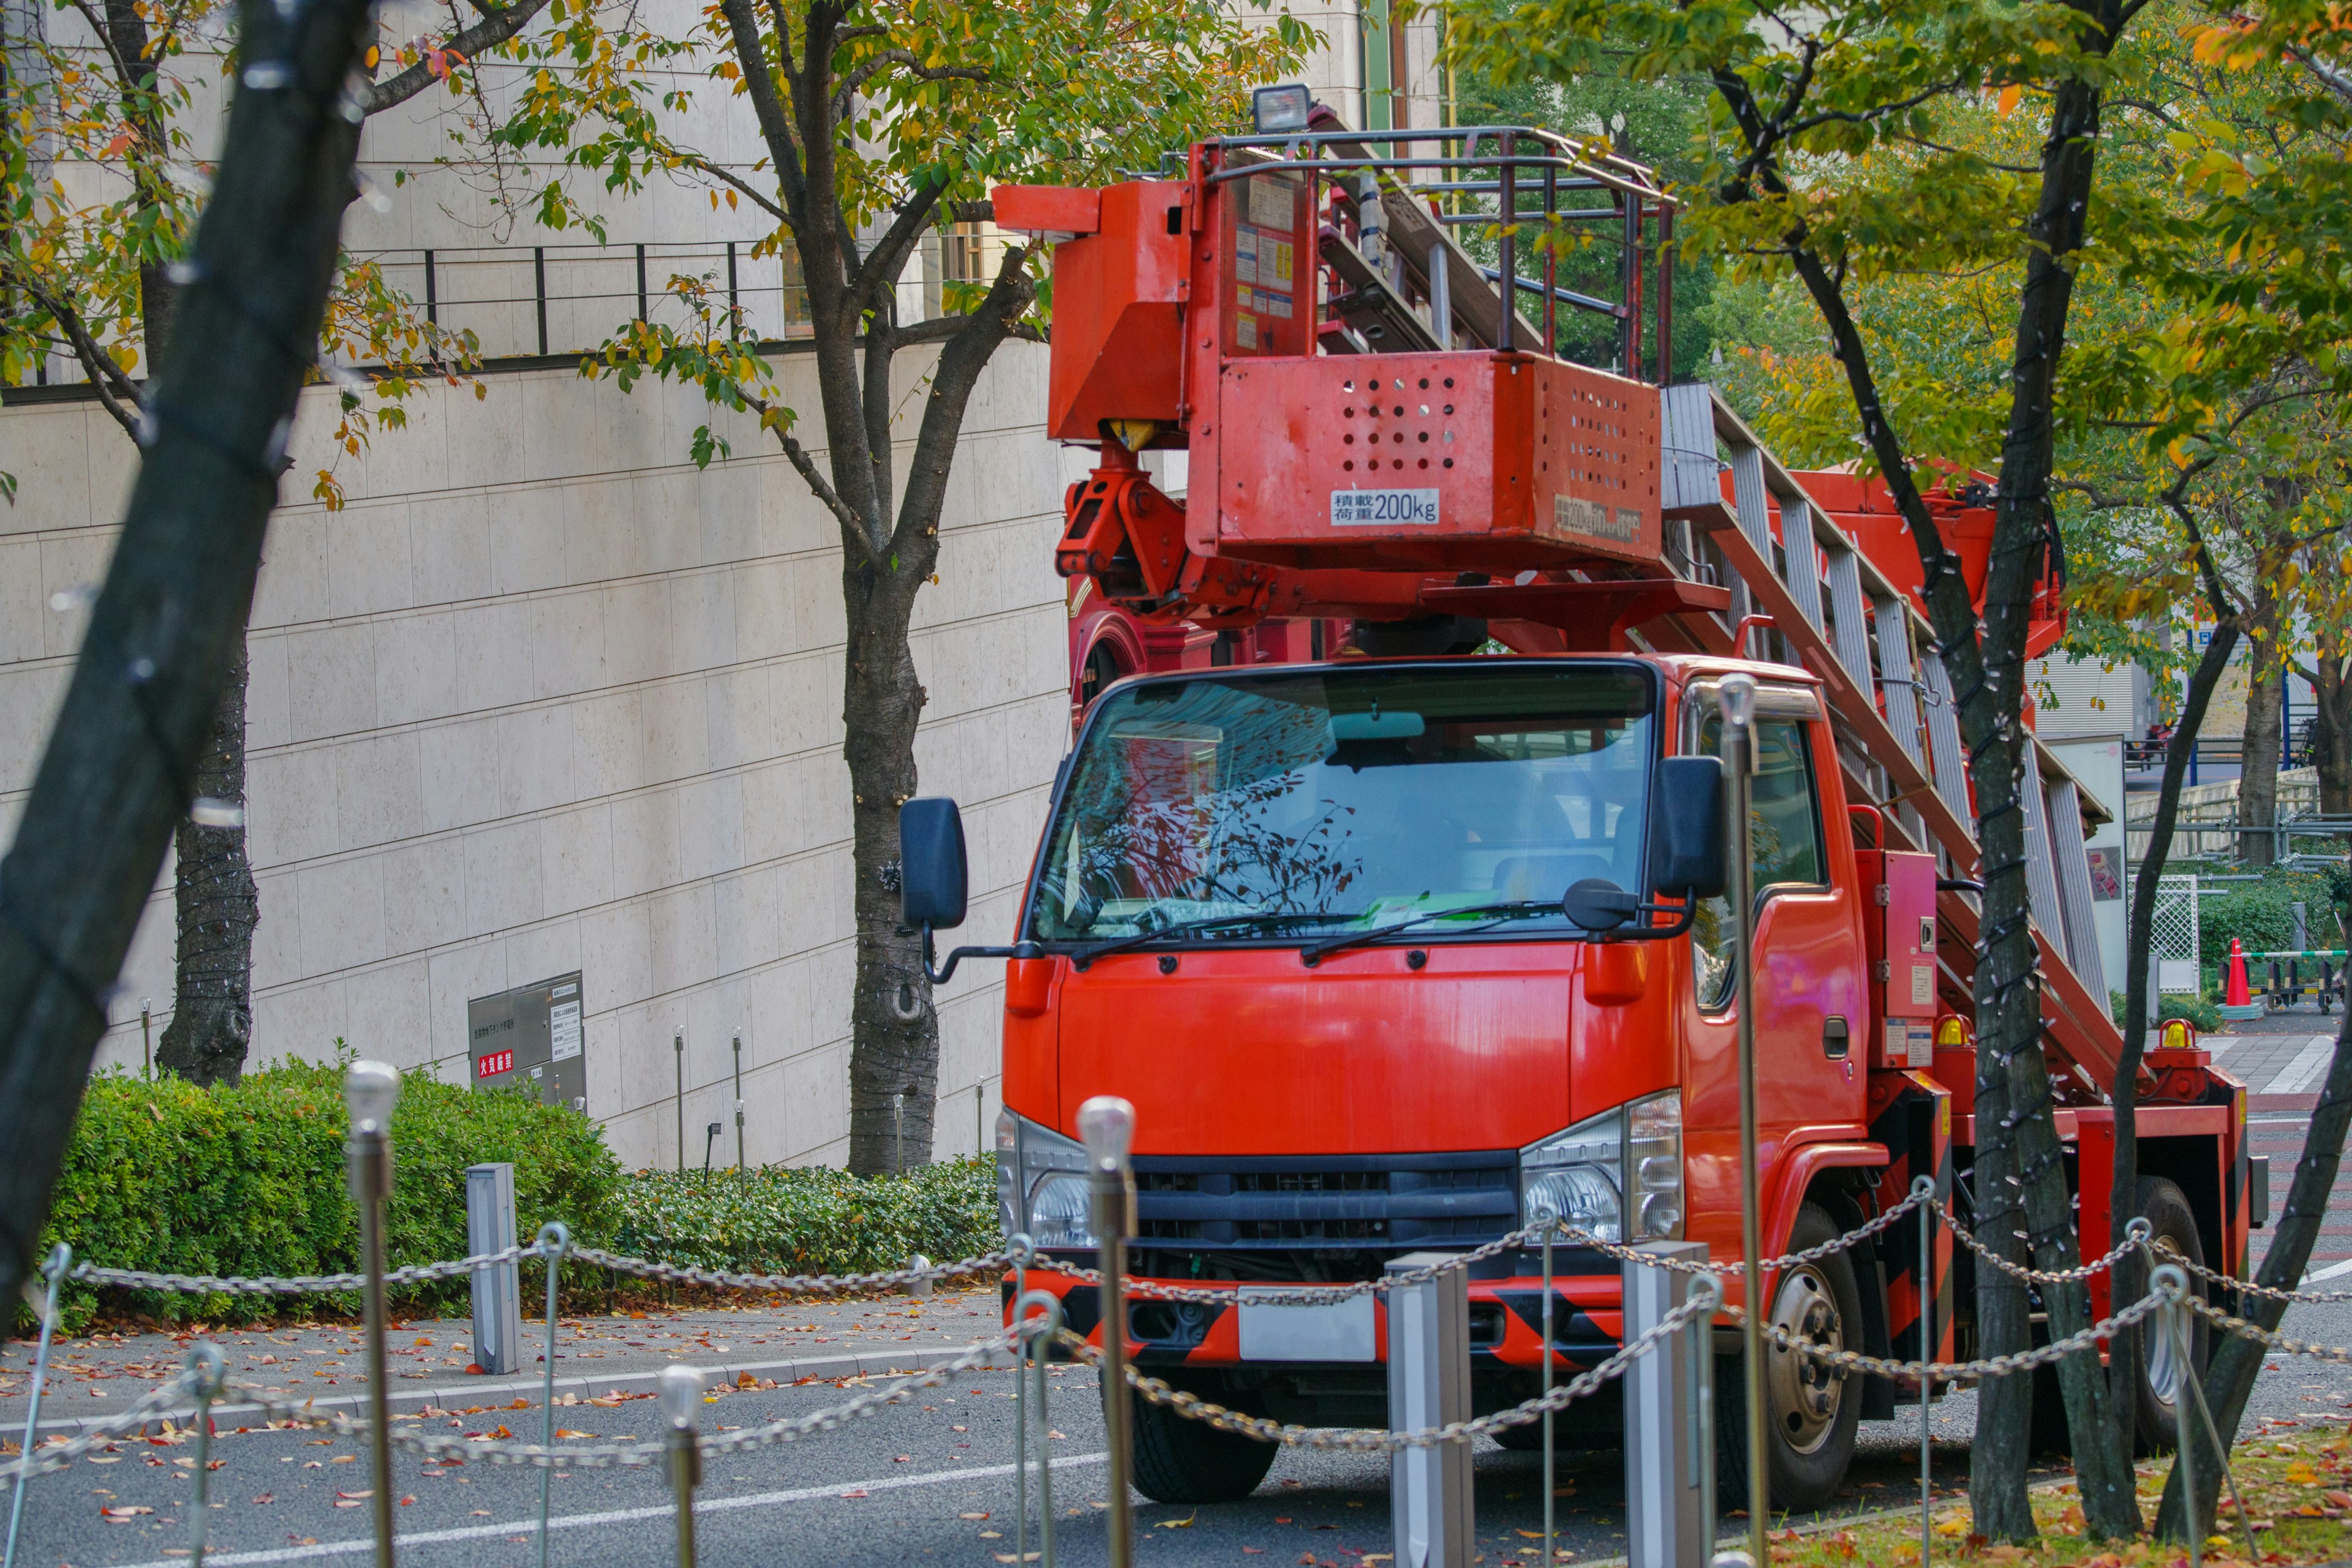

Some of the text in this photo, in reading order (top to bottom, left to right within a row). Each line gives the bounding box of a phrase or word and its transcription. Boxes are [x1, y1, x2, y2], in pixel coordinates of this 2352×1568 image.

[1334, 495, 1373, 507] 積載
[1375, 494, 1436, 521] 200kg
[1334, 508, 1373, 521] 荷重
[481, 1052, 511, 1076] 火気厳禁
